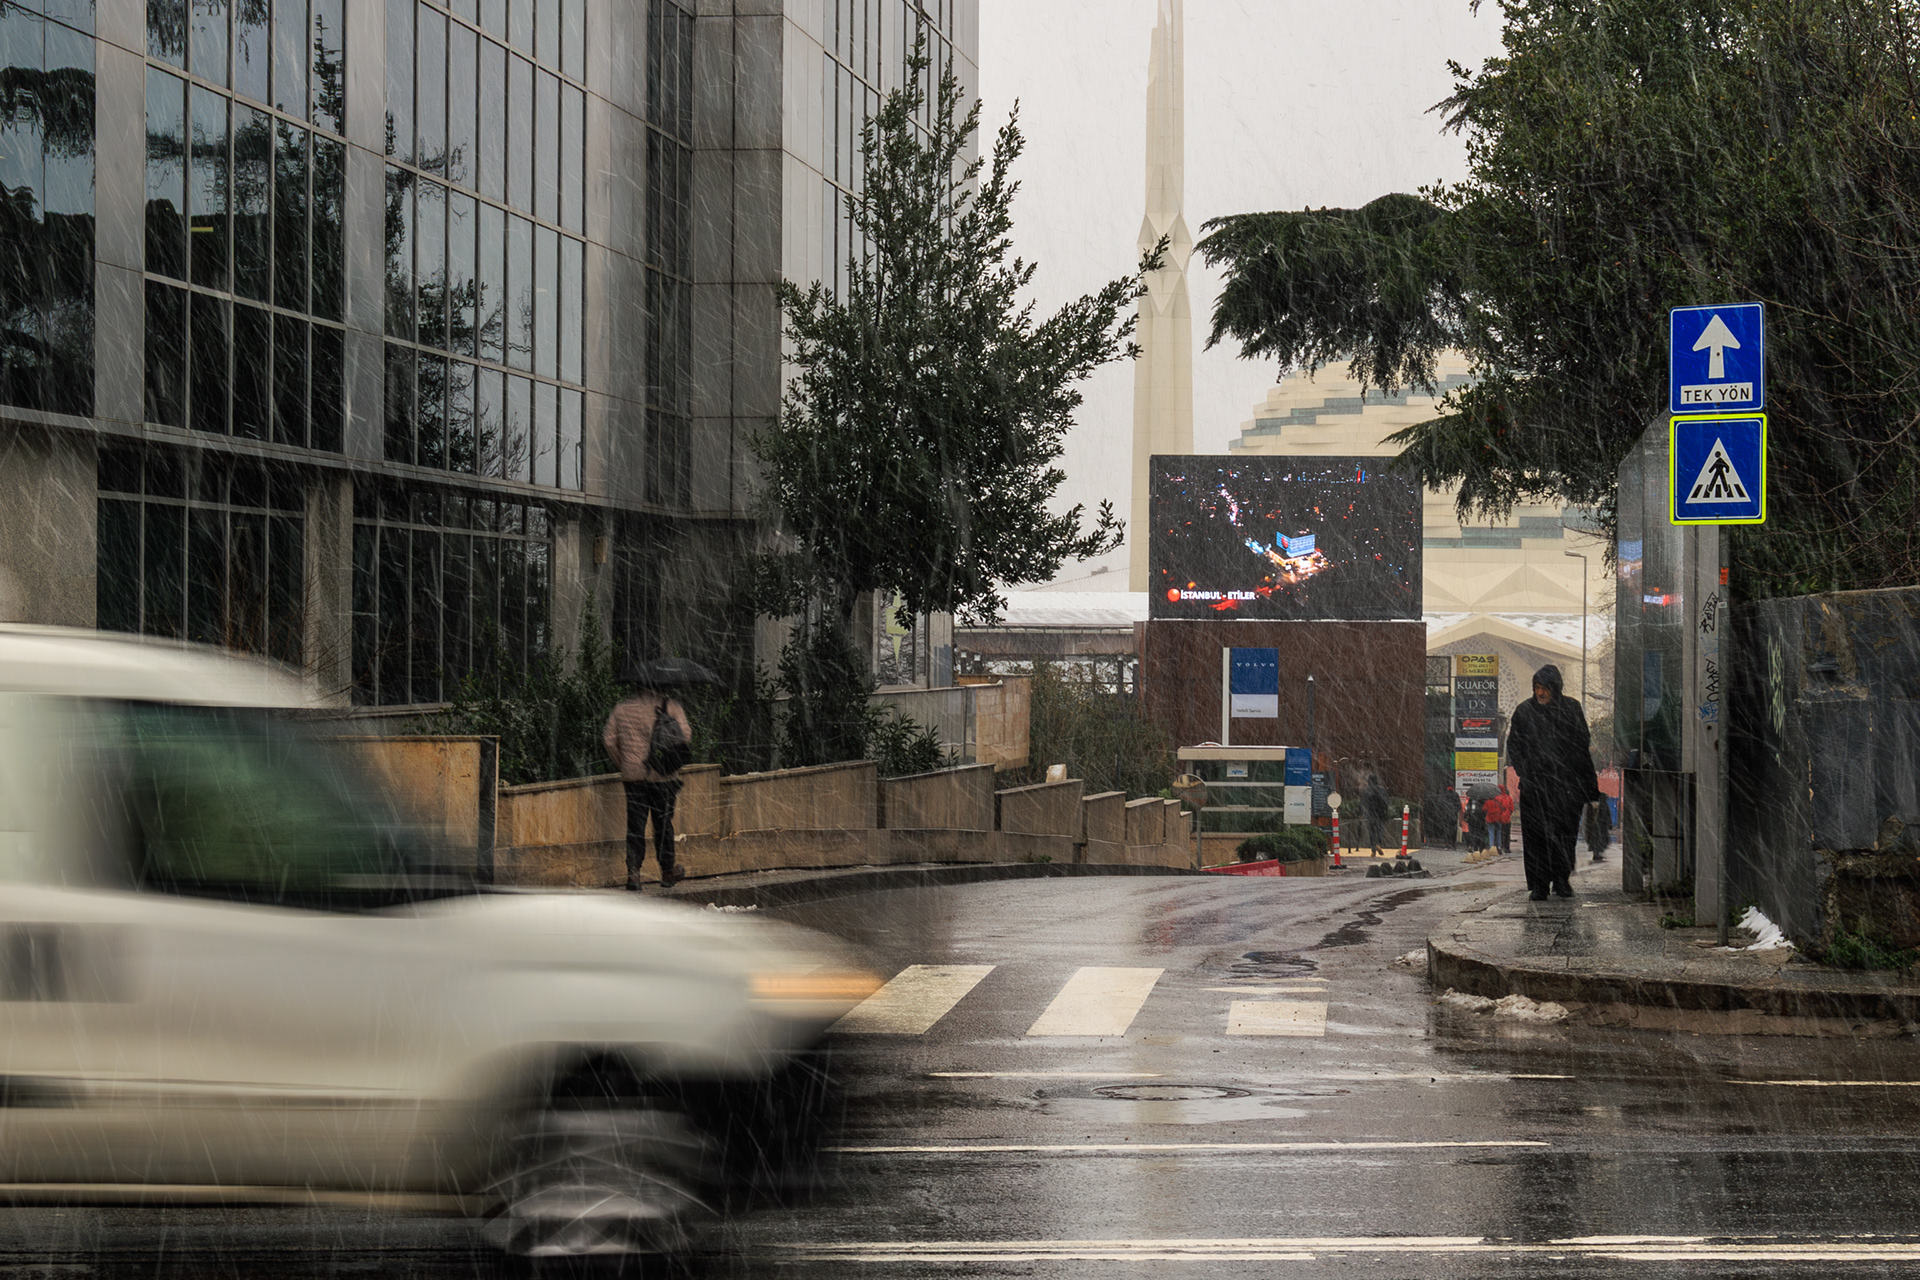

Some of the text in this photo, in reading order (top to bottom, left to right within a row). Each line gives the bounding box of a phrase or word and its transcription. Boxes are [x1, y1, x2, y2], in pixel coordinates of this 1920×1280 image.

[1684, 385, 1749, 402] TEK YÖN
[1180, 589, 1222, 600] İSTANBUL
[1227, 589, 1256, 600] ETİLER
[1461, 655, 1495, 664] OPAŞ
[1457, 680, 1497, 690] KUAFÖR
